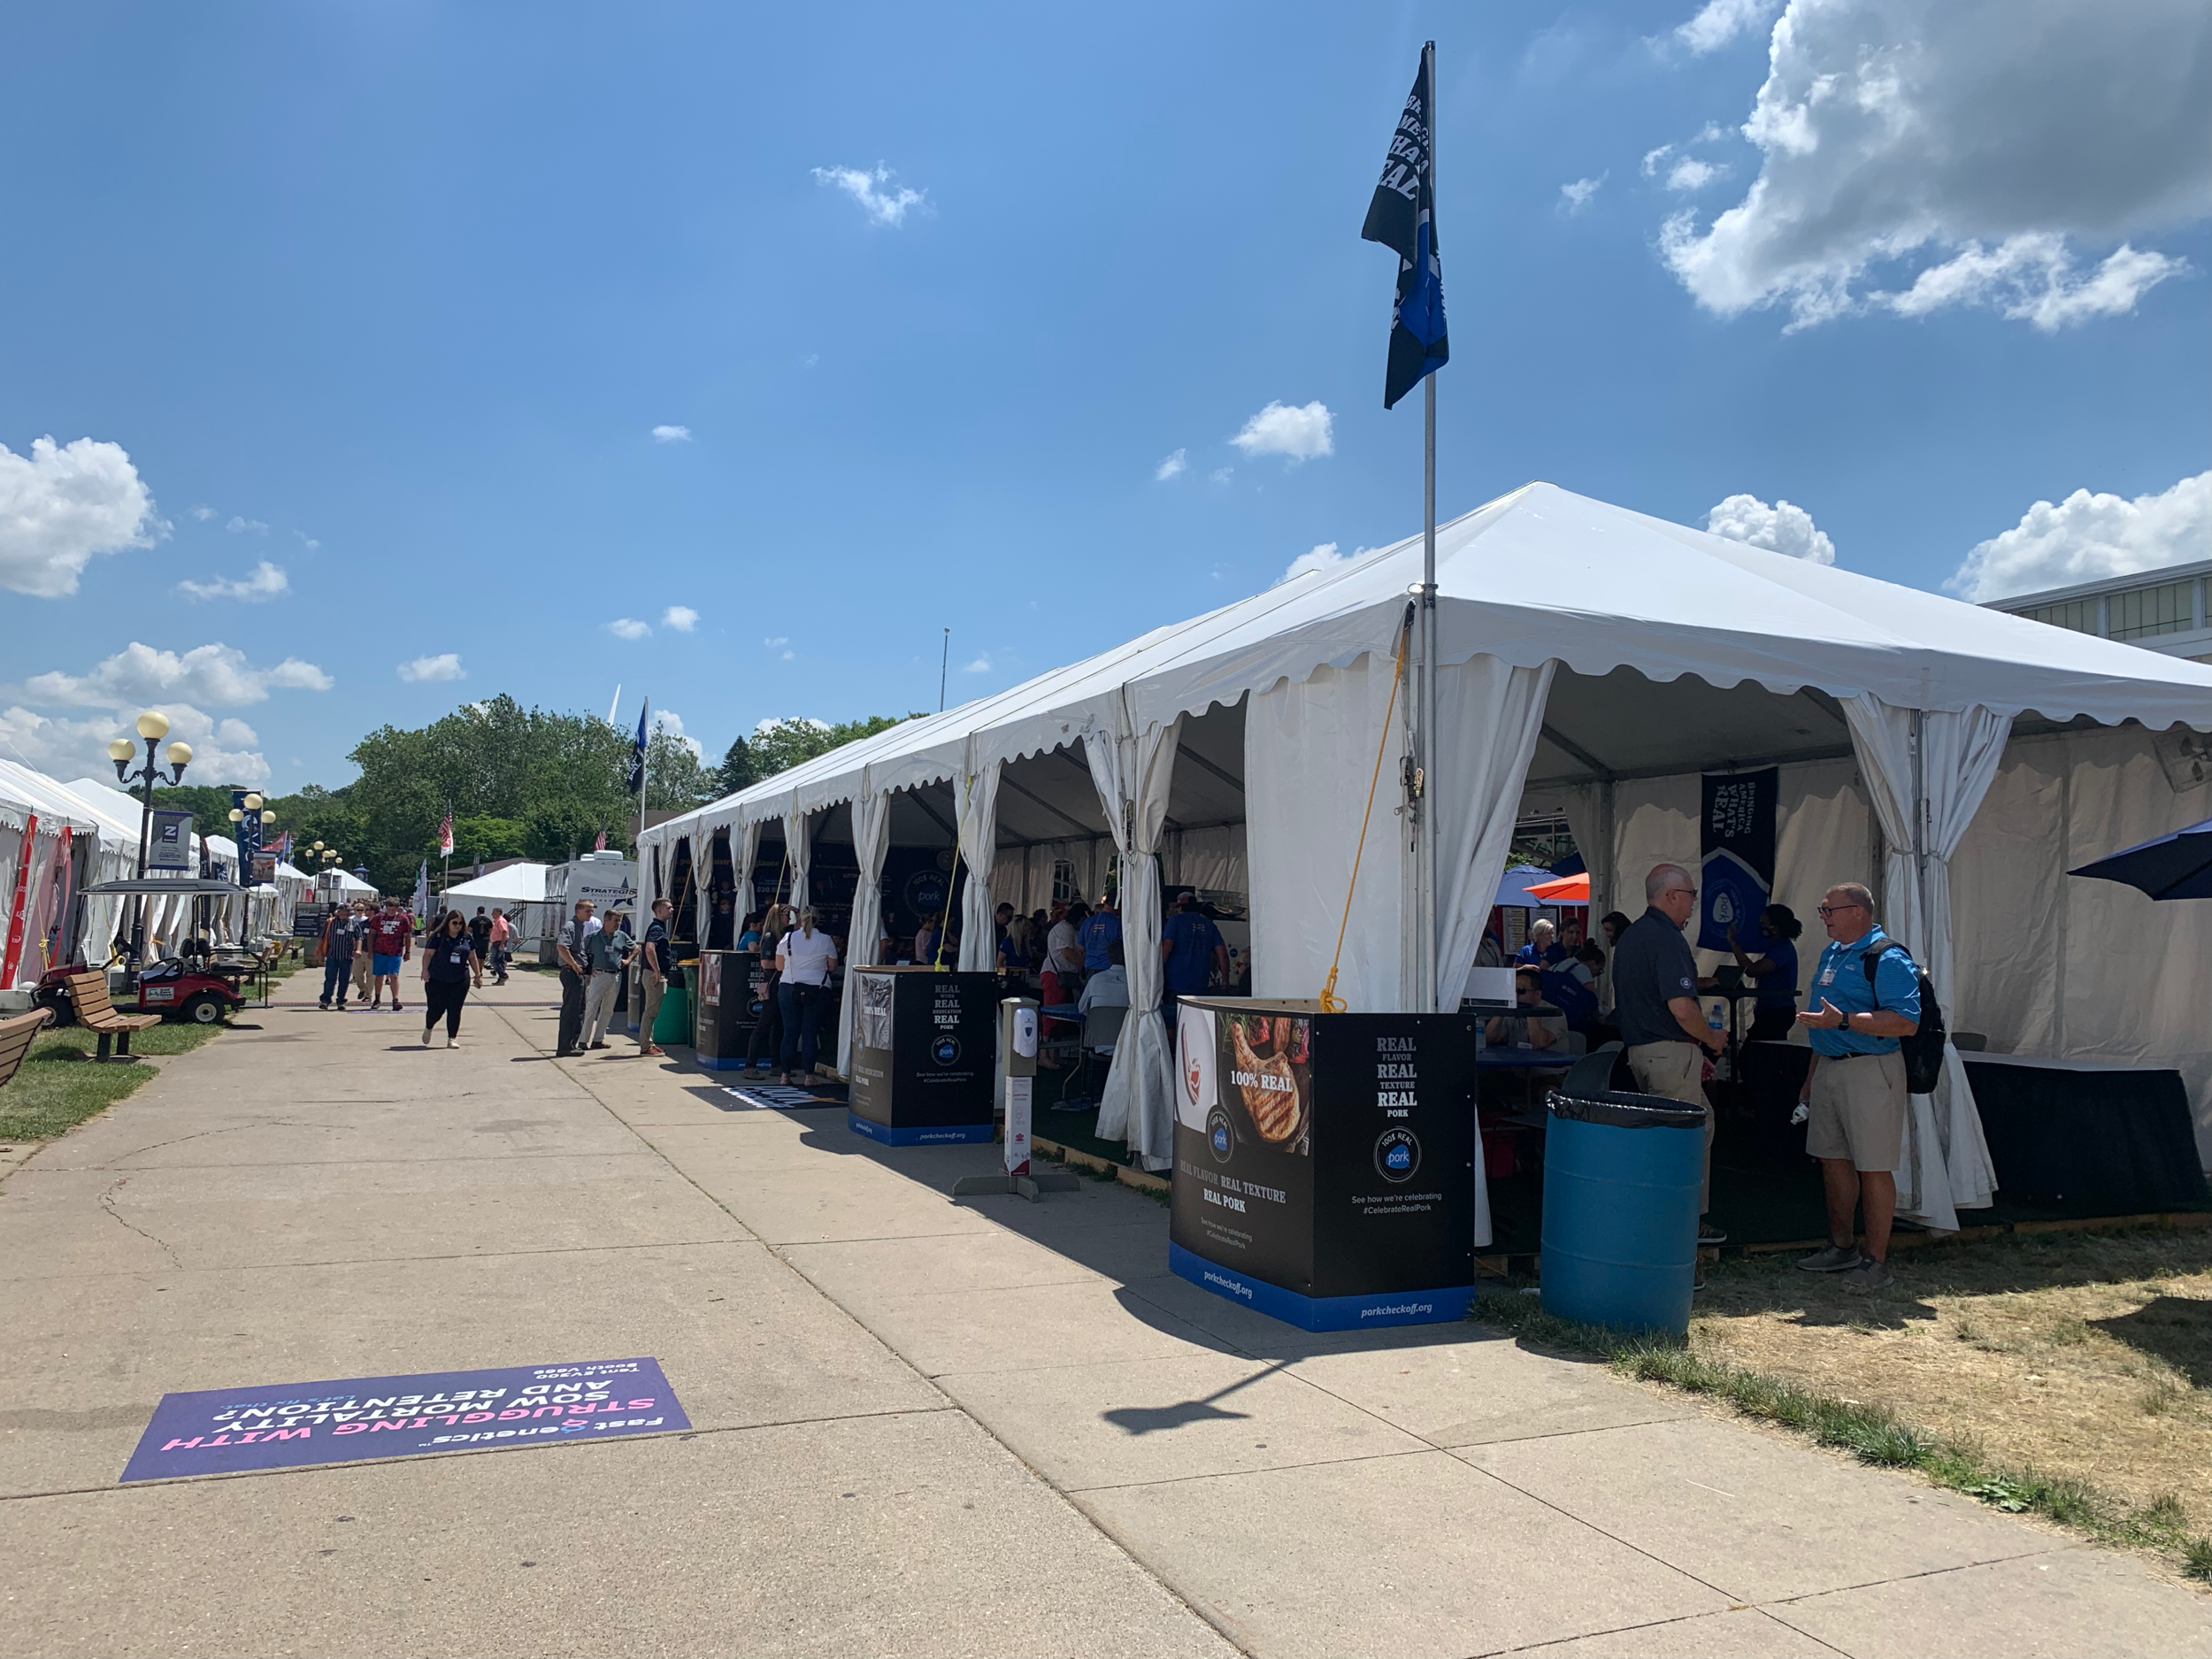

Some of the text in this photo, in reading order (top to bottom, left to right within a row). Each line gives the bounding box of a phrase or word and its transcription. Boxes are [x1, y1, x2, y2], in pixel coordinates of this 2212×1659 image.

[1712, 784, 1727, 833] REAL
[1724, 784, 1738, 838] WHAT'S
[1737, 783, 1747, 832] AMERICA
[1744, 781, 1755, 834] BRINGING
[930, 873, 945, 887] REAL
[918, 891, 941, 903] pork
[1718, 896, 1730, 922] pork
[933, 1015, 960, 1024] REAL
[1377, 1037, 1417, 1052] REAL
[1377, 1064, 1417, 1079] REAL
[1231, 1070, 1293, 1093] 100% REAL
[1378, 1091, 1417, 1107] REAL
[919, 1132, 966, 1141] porkcheckoff.org
[1214, 1133, 1227, 1146] pork
[1381, 1133, 1413, 1147] 100% REAL
[1388, 1150, 1409, 1166] pork
[1193, 1165, 1219, 1186] FLAVOR
[1221, 1175, 1242, 1193] REAL
[1242, 1181, 1286, 1204] TEXTURE
[1203, 1188, 1247, 1214] REAL PORK
[1404, 1192, 1442, 1202] celebrating
[1363, 1203, 1432, 1215] #CelebrateRealPork
[1228, 1227, 1253, 1242] celebrating
[1204, 1271, 1253, 1300] porkcheckoff.org
[1361, 1302, 1433, 1319] porkcheckoff.org
[536, 1371, 595, 1379] EV300
[212, 1379, 614, 1421] AND RETENTION?
[211, 1390, 611, 1433] SOW MORTALITY
[160, 1398, 656, 1452] STRUGGLING WITH
[593, 1417, 664, 1431] Fast
